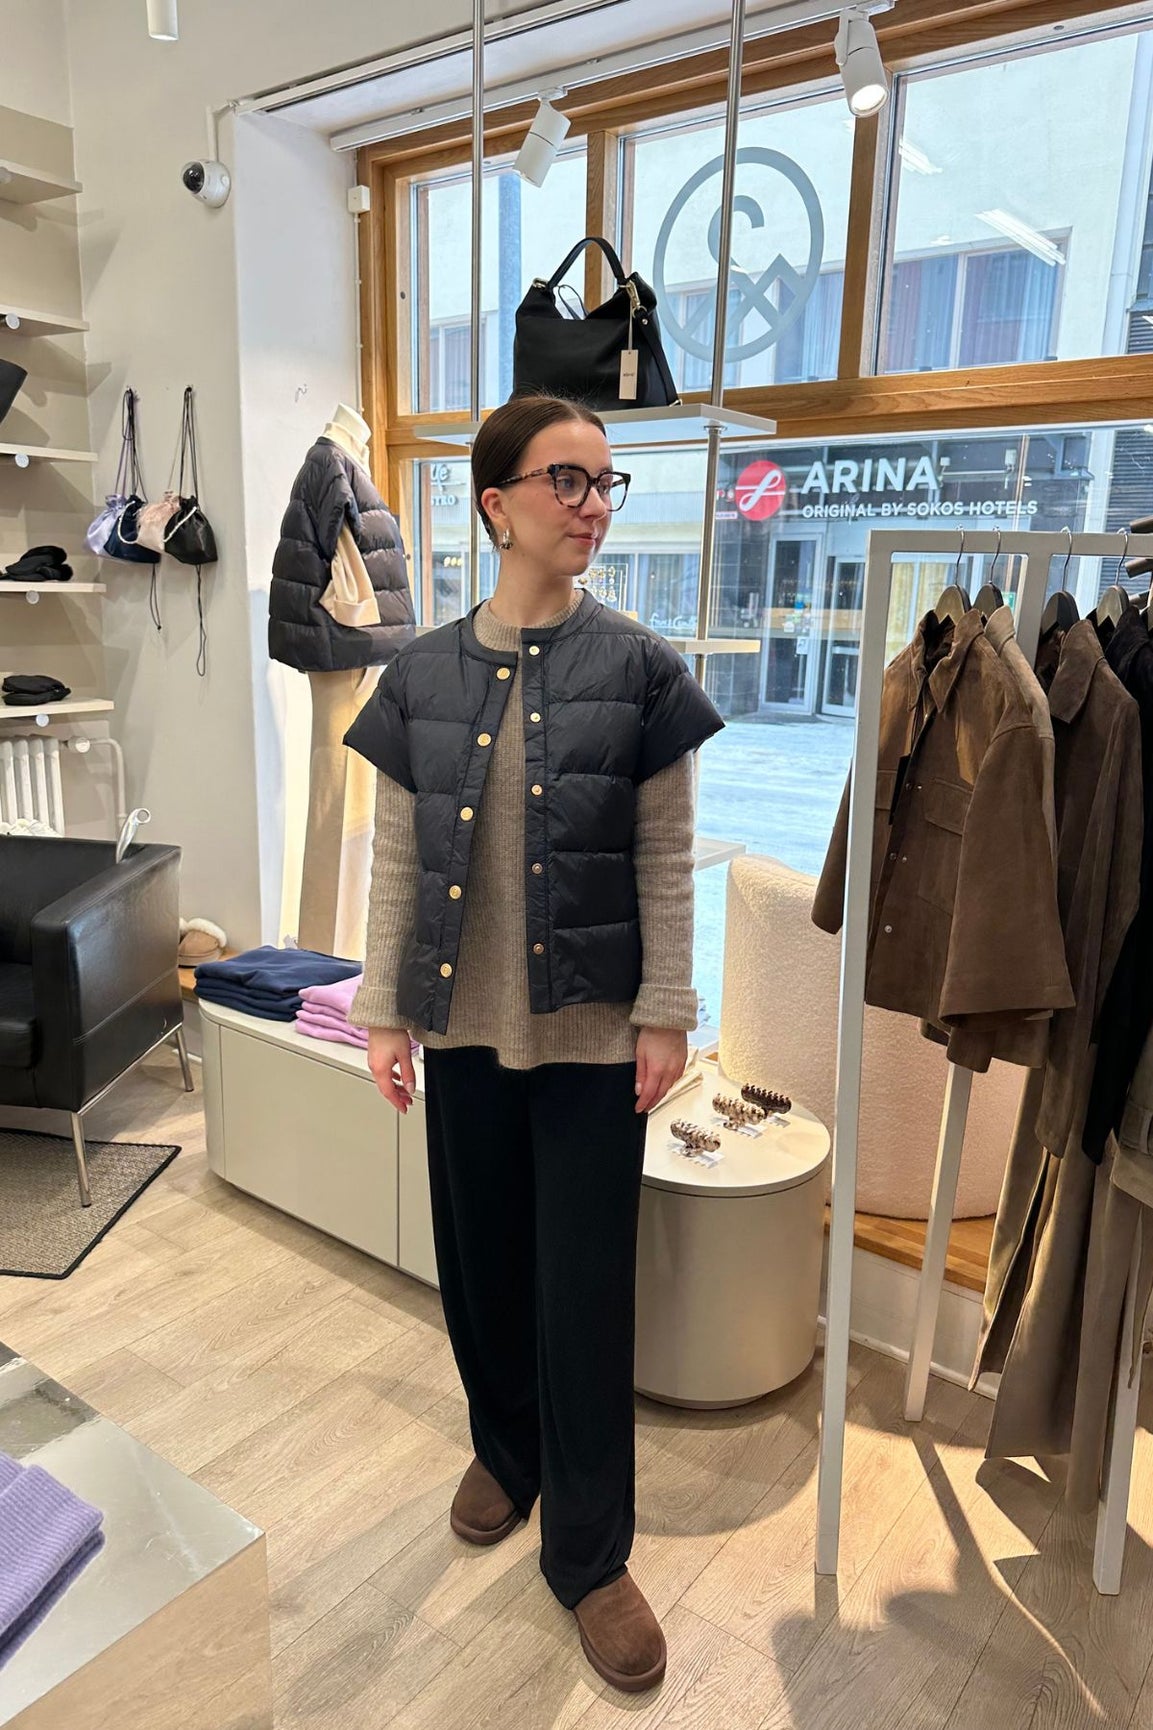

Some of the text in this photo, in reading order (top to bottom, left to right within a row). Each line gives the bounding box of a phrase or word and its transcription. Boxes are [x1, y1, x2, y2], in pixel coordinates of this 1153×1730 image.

[801, 456, 939, 494] ARINA
[802, 500, 1038, 518] ORIGINAL BY SOKOS HOTELS
